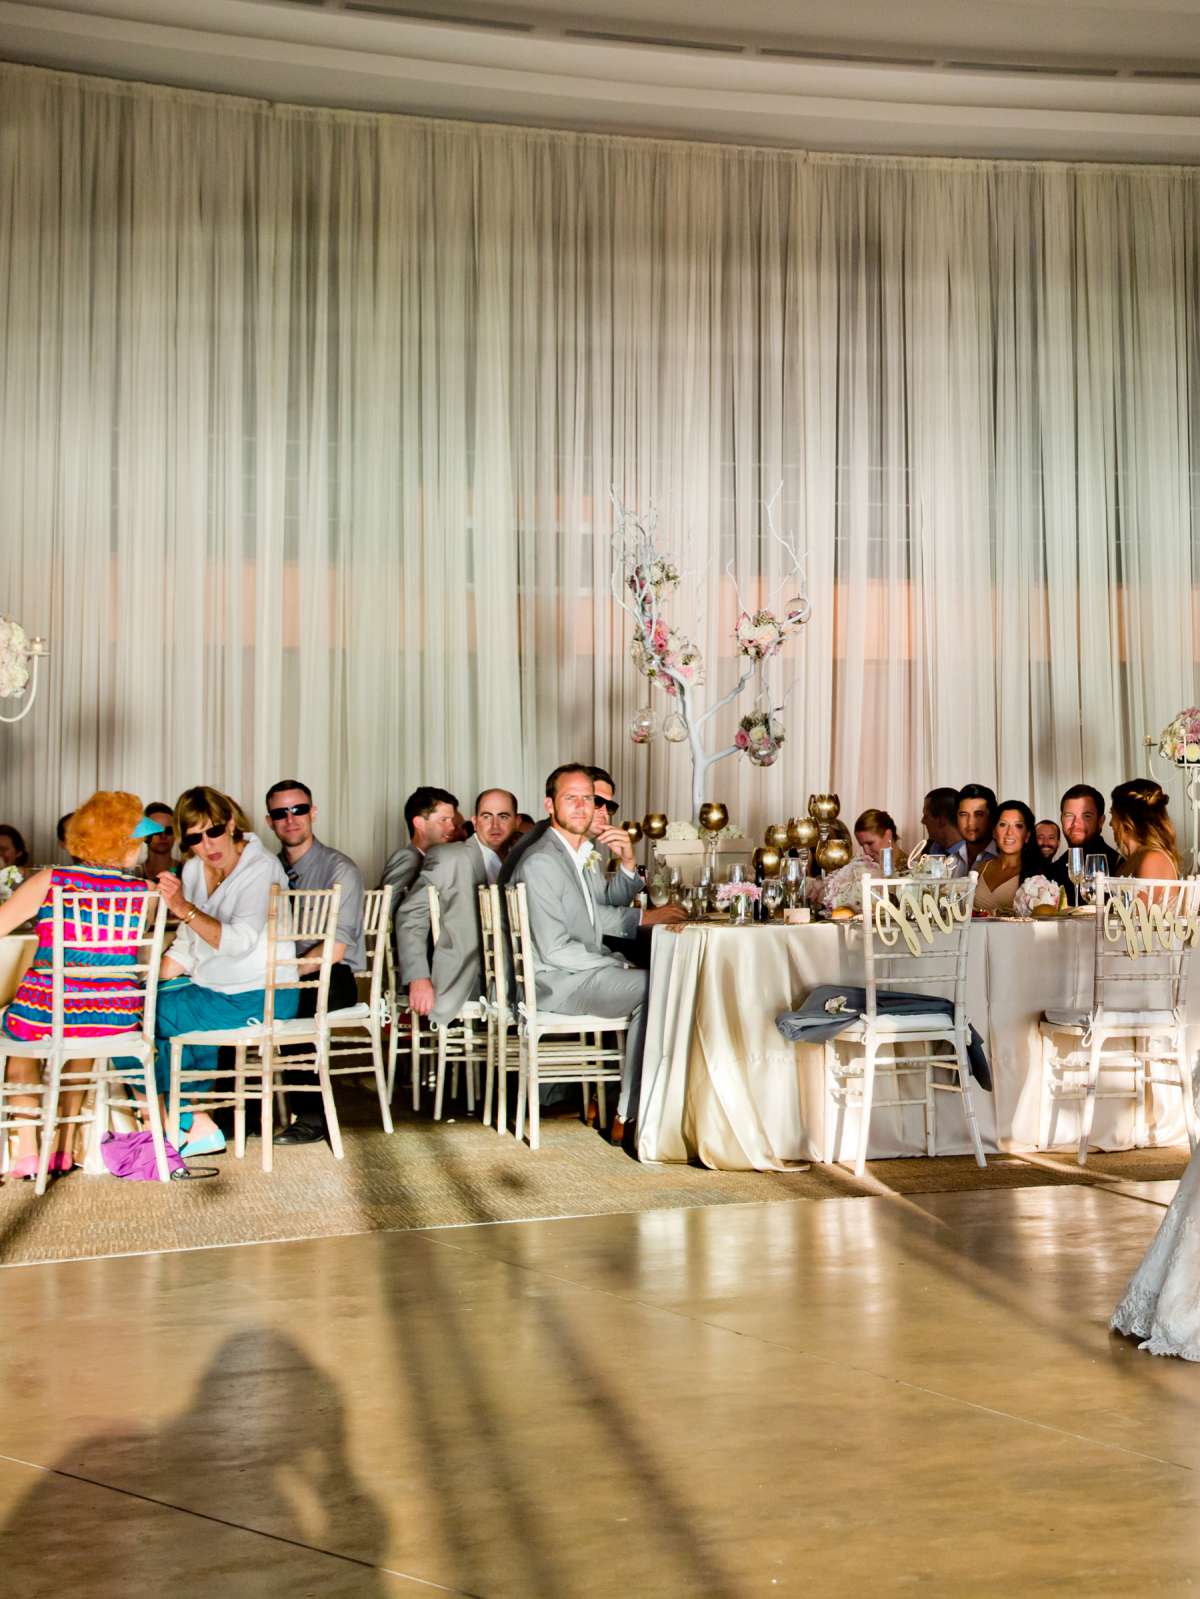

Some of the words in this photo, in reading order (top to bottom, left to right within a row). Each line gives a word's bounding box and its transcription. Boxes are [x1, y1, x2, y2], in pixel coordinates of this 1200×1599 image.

[907, 839, 958, 870] loe
[876, 893, 970, 957] Mr
[1104, 896, 1200, 960] Mrs
